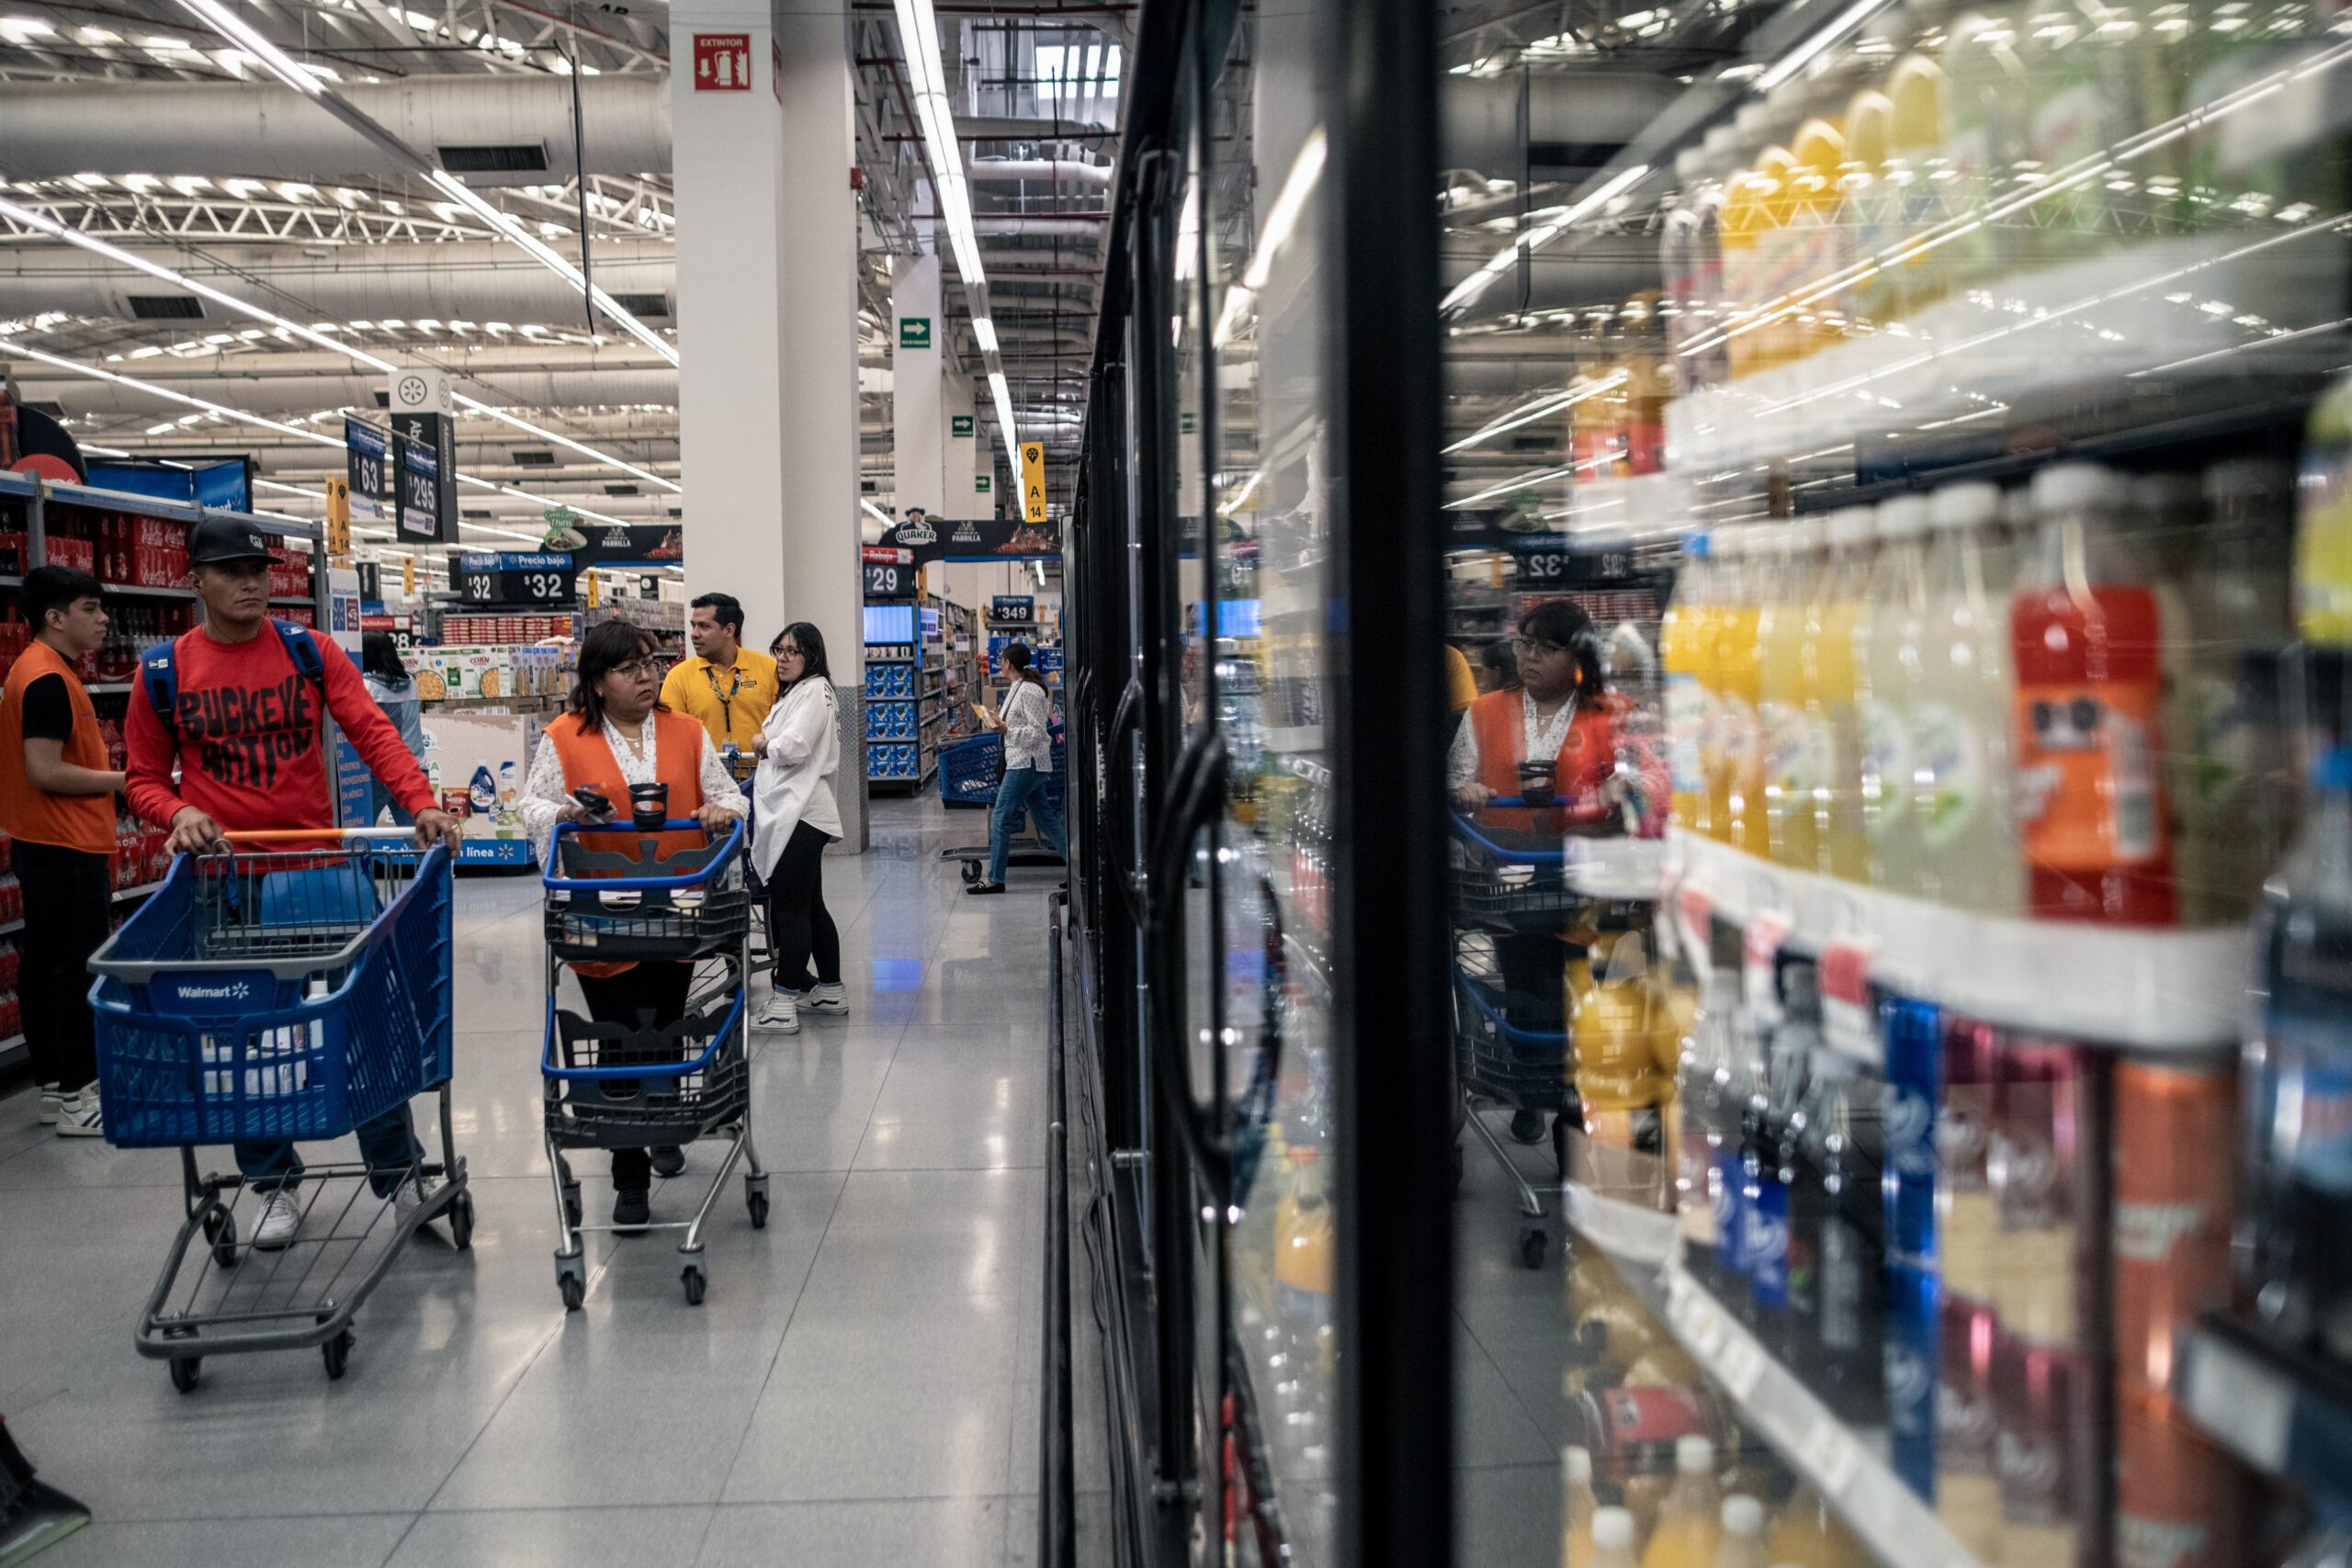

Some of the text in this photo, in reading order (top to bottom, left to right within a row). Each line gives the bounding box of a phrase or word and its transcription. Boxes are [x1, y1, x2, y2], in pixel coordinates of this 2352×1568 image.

[700, 39, 743, 47] EXTINTOR
[1030, 486, 1040, 498] A
[1030, 506, 1042, 518] 14
[341, 521, 347, 532] A
[897, 530, 935, 541] QUAKER
[339, 538, 349, 549] 14
[469, 556, 495, 567] Precio bajo
[518, 555, 545, 565] Precio
[546, 555, 565, 567] bajo
[524, 574, 562, 598] $32
[865, 568, 898, 592] $29
[469, 575, 491, 599] $32
[177, 672, 313, 741] BUCKEYE
[201, 728, 313, 790] NATION
[467, 845, 493, 858] línea
[177, 987, 231, 998] Walmart
